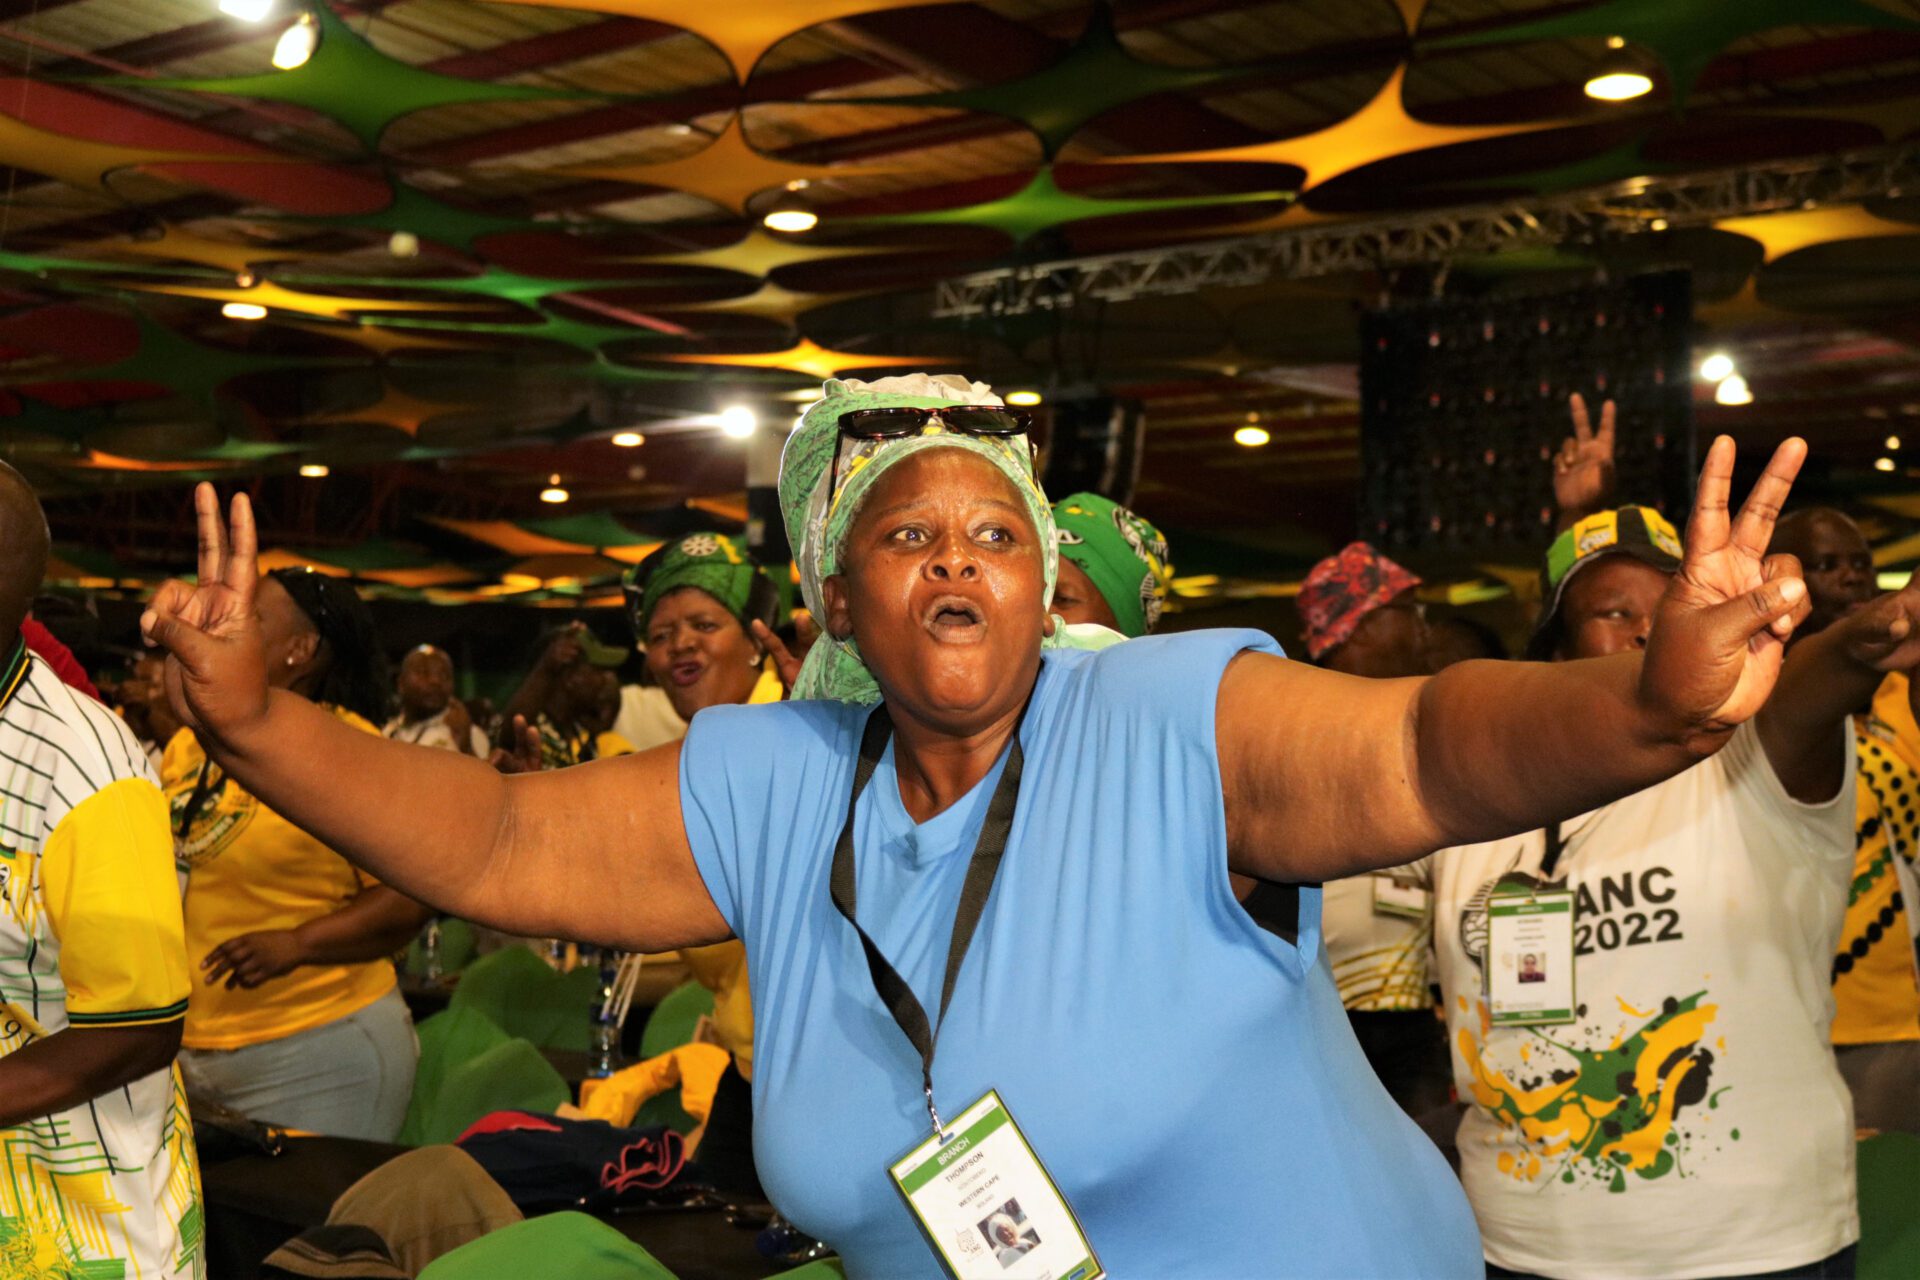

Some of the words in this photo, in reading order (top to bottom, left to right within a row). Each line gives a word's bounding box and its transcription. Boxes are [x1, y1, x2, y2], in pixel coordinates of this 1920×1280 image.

[1575, 866, 1676, 922] ANC
[1575, 908, 1683, 956] 2022
[937, 1137, 971, 1165] BRANCH
[945, 1151, 984, 1182] THOMPSON
[959, 1186, 985, 1208] WESTERN
[984, 1174, 1000, 1188] CAPE
